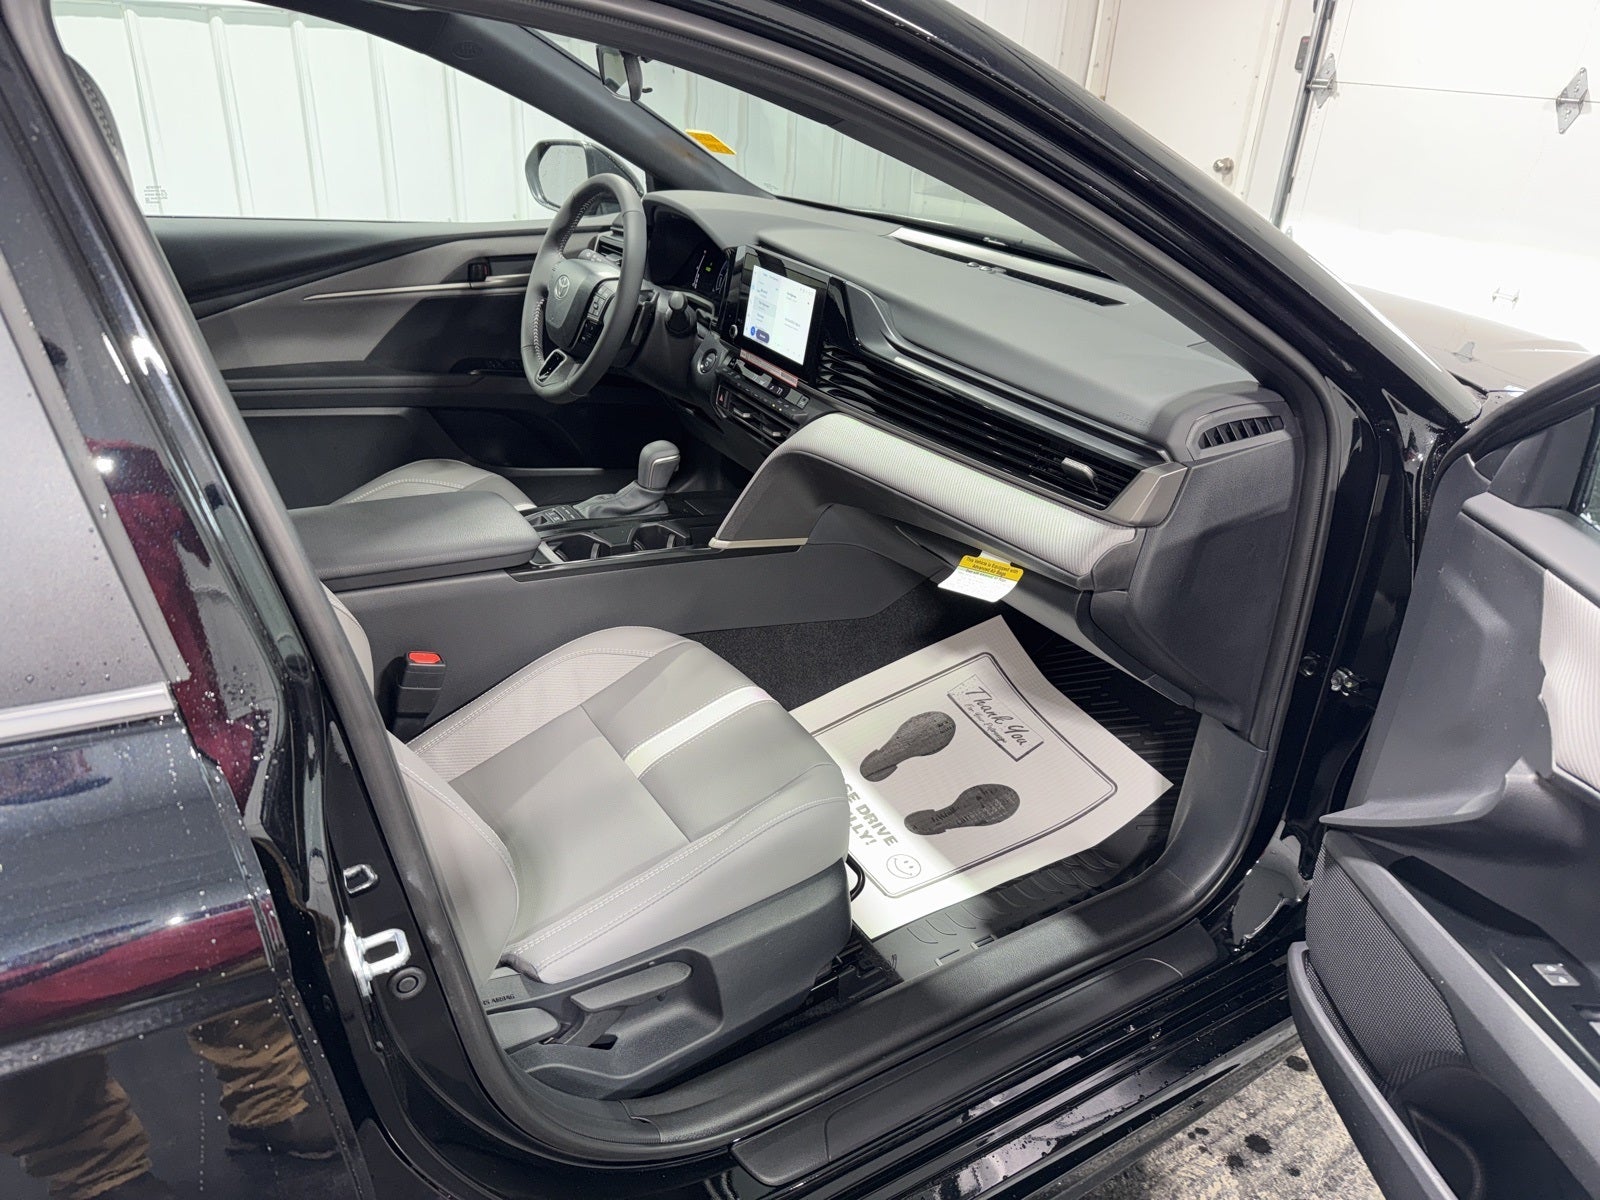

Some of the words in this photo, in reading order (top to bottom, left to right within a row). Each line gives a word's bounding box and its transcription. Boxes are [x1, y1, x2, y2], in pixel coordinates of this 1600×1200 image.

[965, 686, 1014, 725] Thank
[1004, 725, 1030, 746] You
[855, 803, 898, 847] DRIVE
